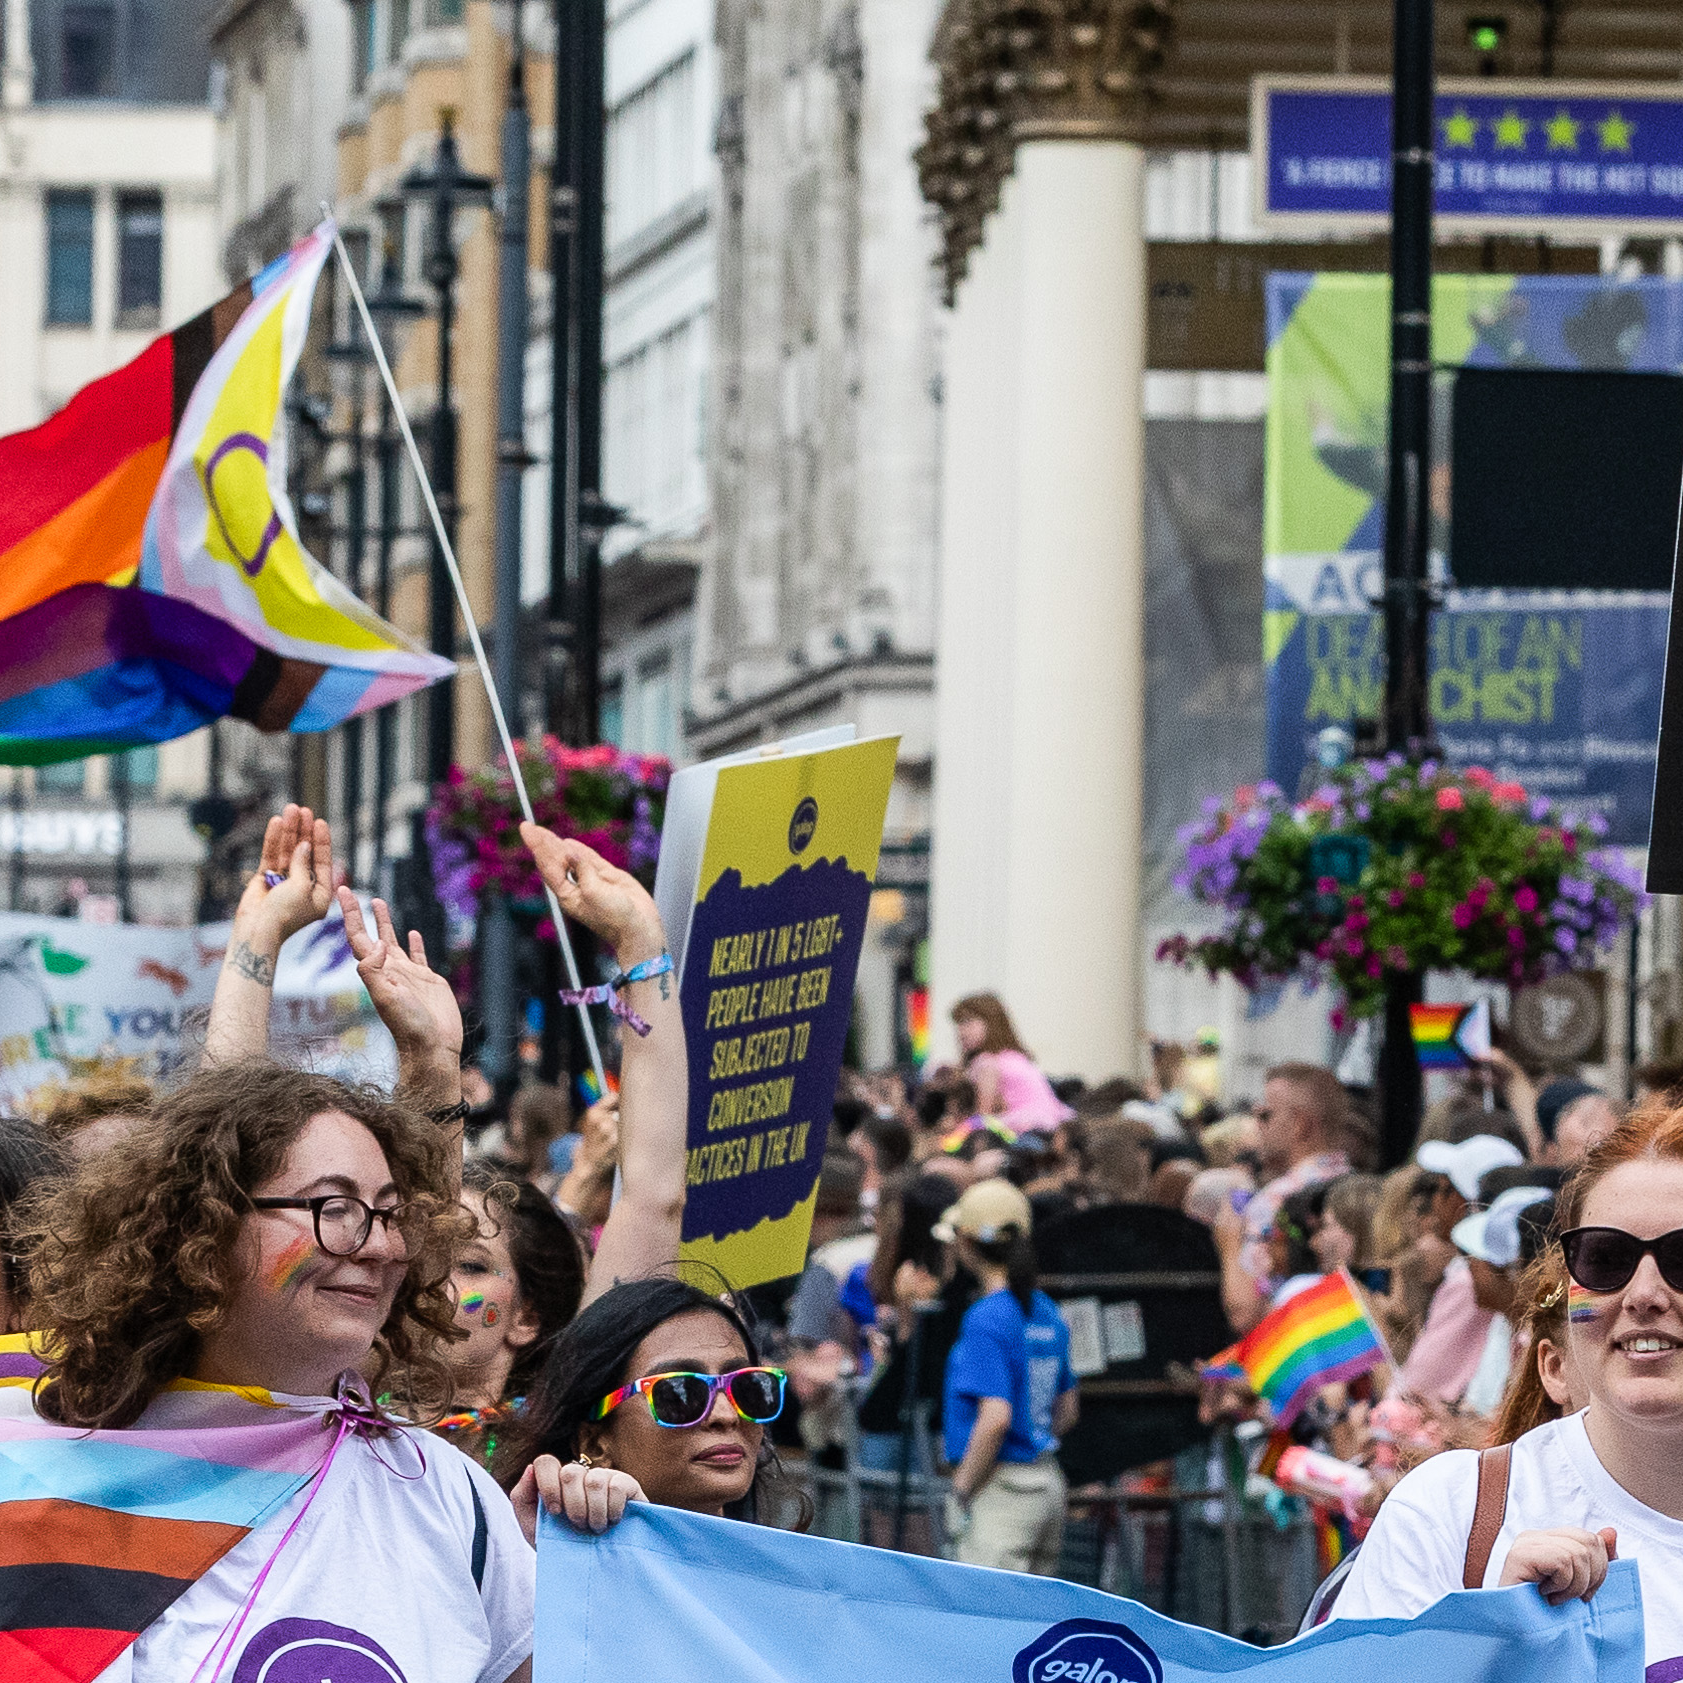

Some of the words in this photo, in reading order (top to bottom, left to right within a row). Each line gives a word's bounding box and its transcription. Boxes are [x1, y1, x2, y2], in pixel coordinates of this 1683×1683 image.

[1305, 614, 1450, 667] DEAH
[1303, 665, 1560, 724] ANCHIST
[709, 930, 766, 977] NEARLY
[775, 925, 792, 966] IN
[790, 922, 804, 962] 5
[803, 914, 843, 959] LGBT+
[705, 982, 760, 1030] PEOPLE
[759, 975, 798, 1021] HAVE
[796, 966, 832, 1011] BEEN
[709, 1027, 792, 1080] SUBJECTED
[790, 1021, 811, 1062] TO
[707, 1076, 795, 1131] CONVERSION
[686, 1137, 746, 1185] ACTICES
[745, 1132, 764, 1173] IN
[763, 1126, 791, 1169] THE
[789, 1121, 811, 1163] UK
